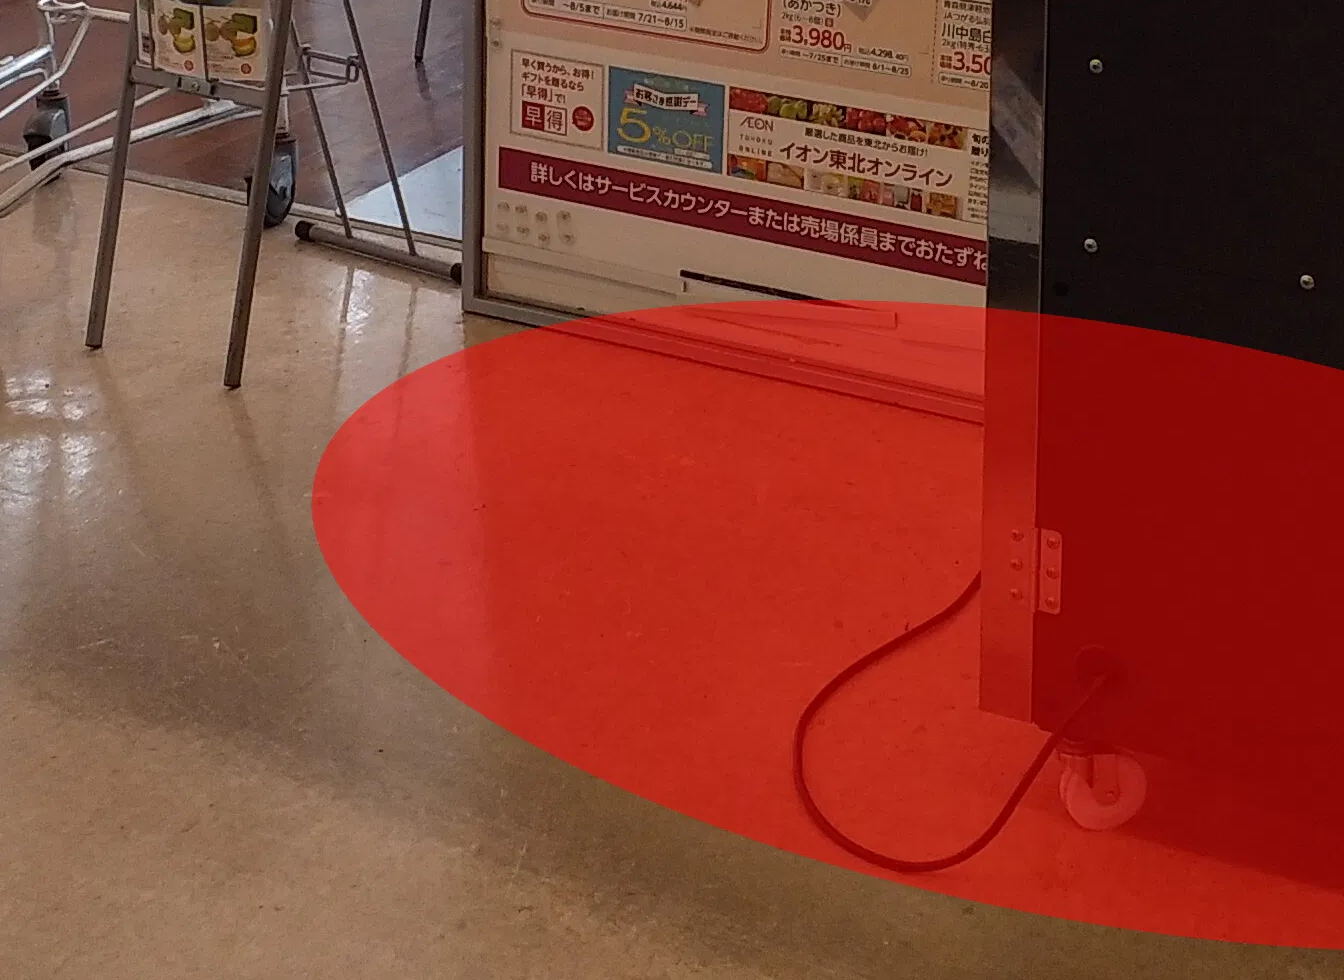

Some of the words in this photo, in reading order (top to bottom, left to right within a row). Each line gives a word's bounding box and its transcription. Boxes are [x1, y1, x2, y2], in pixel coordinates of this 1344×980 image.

[791, 24, 852, 54] 3,980円
[521, 57, 595, 80] 早く買うから、お得!
[521, 71, 584, 92] ギフトを贈るなら
[525, 106, 563, 132] 早得
[804, 126, 928, 157] 厳選した商品を東北からお届け!
[779, 142, 953, 188] イオン東北オンライン
[529, 160, 988, 271] 詳しくはサービスカウンターまたは売場係員までおたずね
